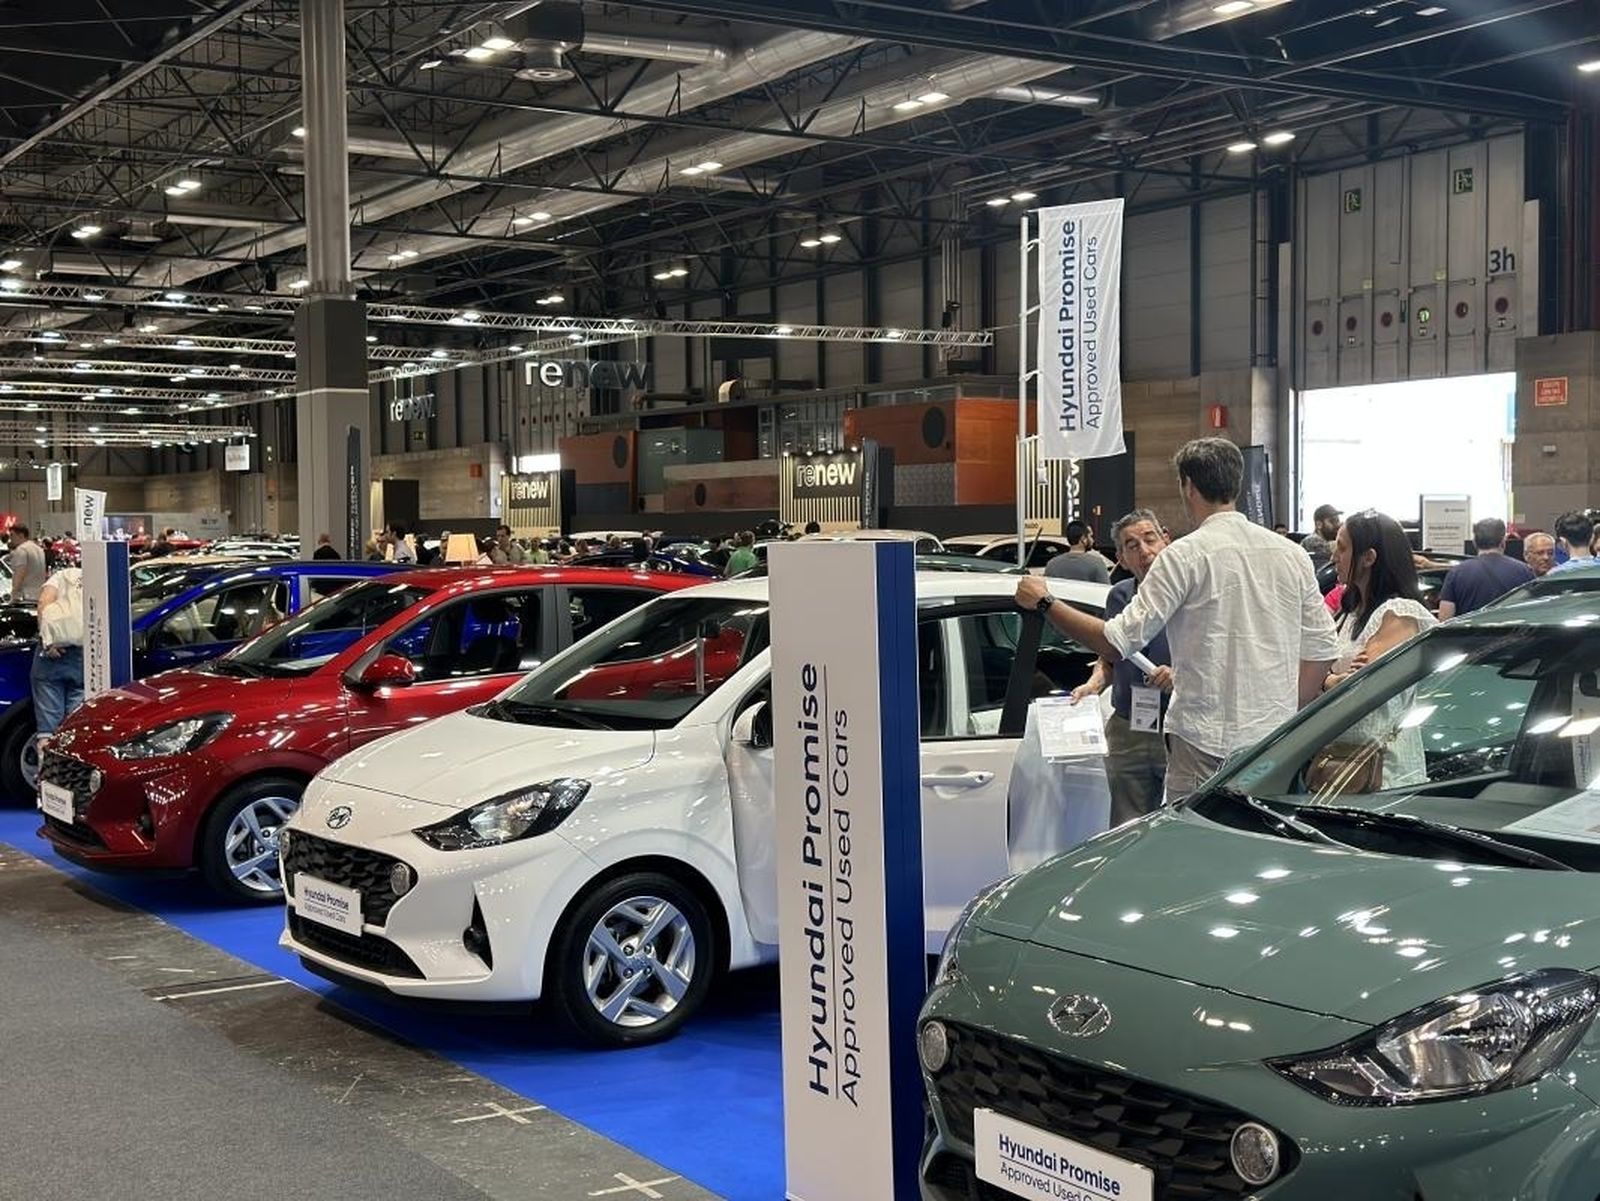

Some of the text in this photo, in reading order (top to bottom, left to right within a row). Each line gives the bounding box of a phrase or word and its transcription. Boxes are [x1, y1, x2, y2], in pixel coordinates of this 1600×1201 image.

[1489, 246, 1516, 273] 3h
[1058, 220, 1078, 431] Hyundai Promise
[1084, 236, 1102, 429] Approved Used Cars
[525, 361, 648, 389] renew
[511, 481, 549, 500] renew
[796, 462, 856, 487] renew
[798, 664, 832, 1095] Hyundai Promise
[833, 710, 861, 1107] Approved Used Cars
[999, 1133, 1120, 1195] Hyundai Promise
[1000, 1161, 1081, 1201] Approved Used
